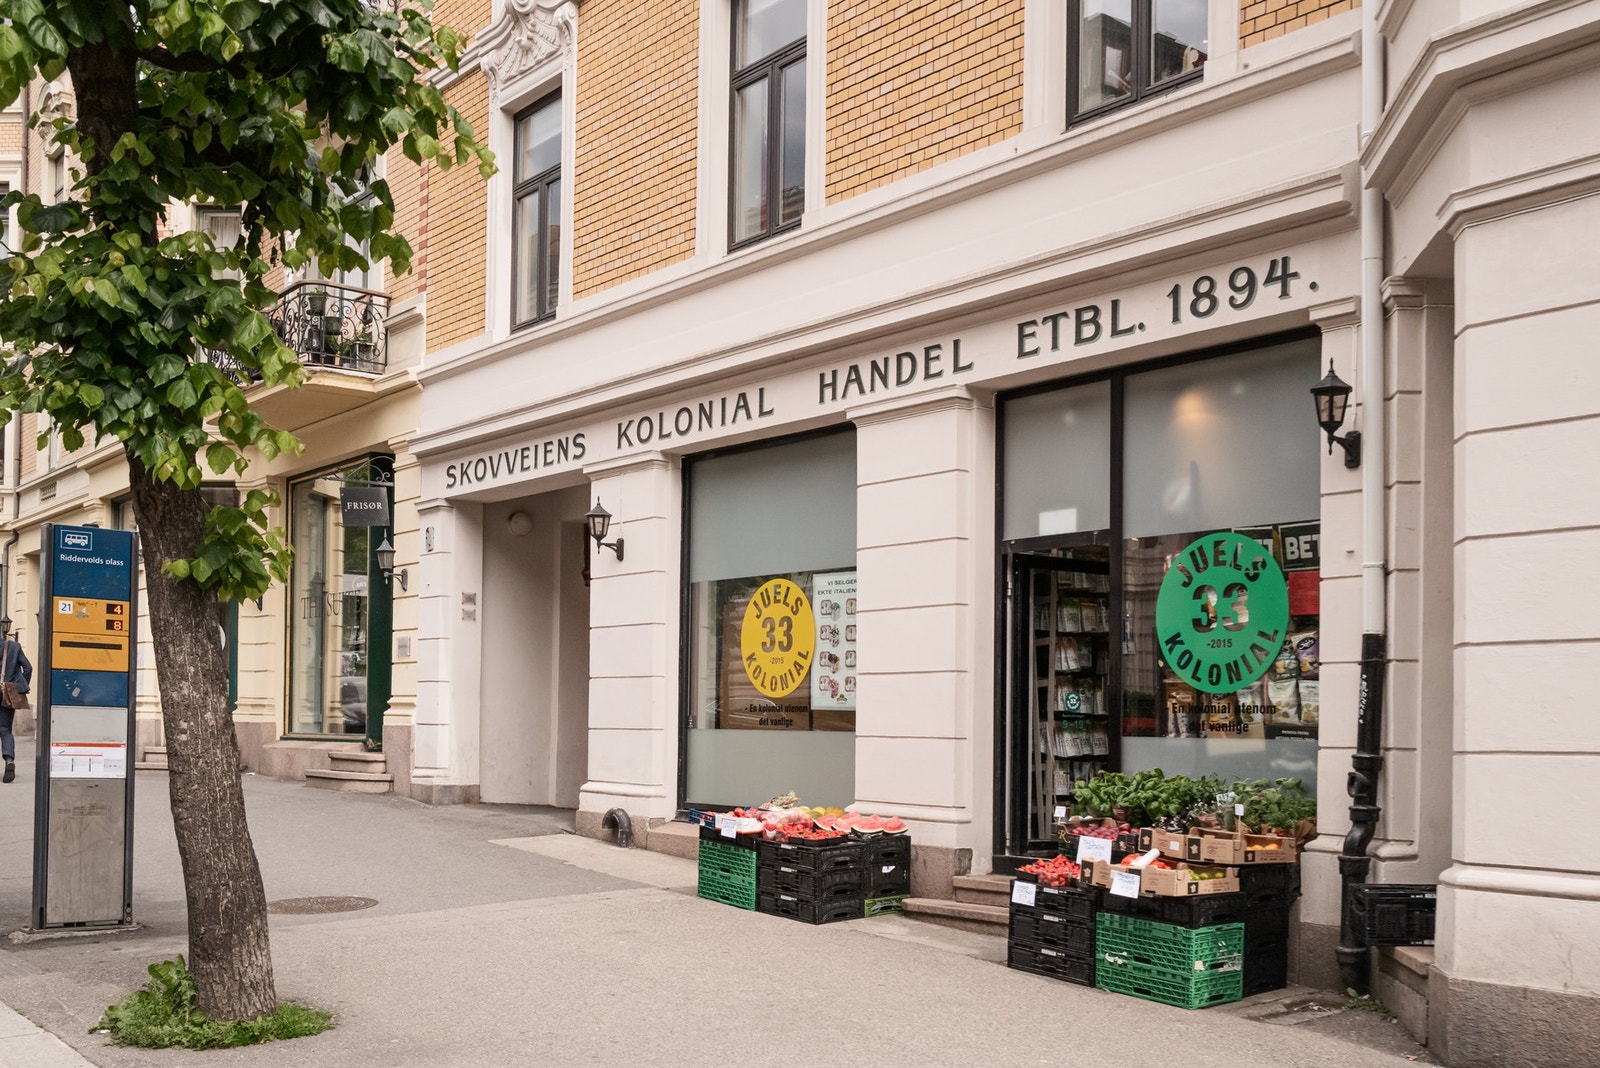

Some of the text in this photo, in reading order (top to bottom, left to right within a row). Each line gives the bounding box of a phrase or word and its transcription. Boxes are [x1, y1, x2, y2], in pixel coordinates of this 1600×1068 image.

[445, 256, 1320, 489] SKOVVEIENS KOLONIAL HANDEL ETBL. 1894.
[346, 501, 383, 510] FRISØR
[60, 553, 105, 565] Riddervolds
[1176, 539, 1267, 588] JUELS
[60, 602, 72, 612] 21
[113, 605, 122, 614] 4
[752, 583, 804, 619] JUELS
[1191, 582, 1250, 633] 33
[113, 621, 122, 631] 8
[761, 616, 794, 653] 33
[1164, 627, 1280, 687] KOLONIAL
[745, 649, 810, 693] KOLONIAL
[749, 704, 758, 713] En
[758, 703, 784, 713] kolonial
[784, 704, 809, 713] utenom
[758, 716, 793, 728] det vanlige
